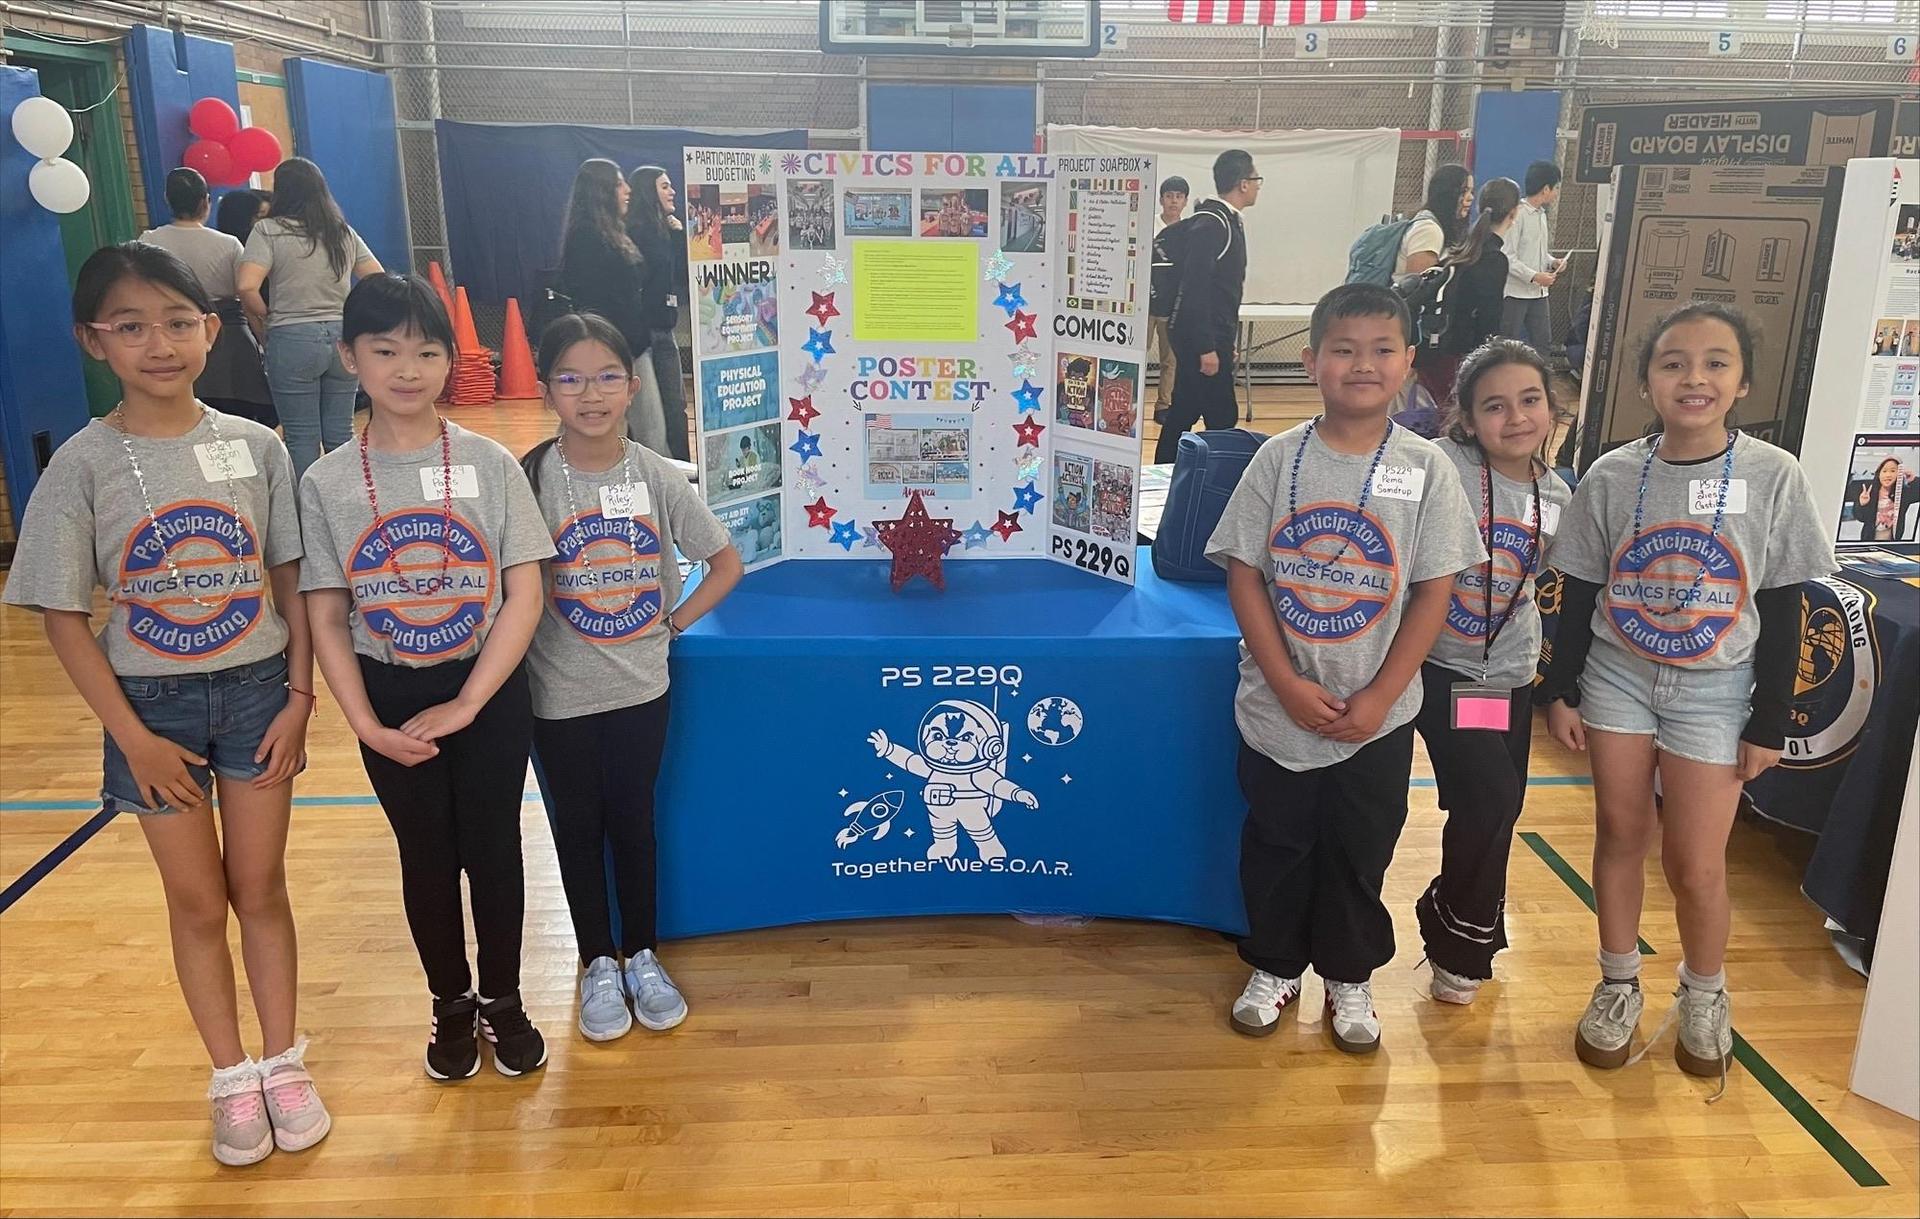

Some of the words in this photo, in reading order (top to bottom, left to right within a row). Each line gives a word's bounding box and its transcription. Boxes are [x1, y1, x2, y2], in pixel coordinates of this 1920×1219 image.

[1104, 25, 1117, 46] 2
[1305, 33, 1318, 53] 3
[1718, 32, 1732, 51] 5
[1894, 37, 1906, 56] 6
[1668, 114, 1732, 130] HEADER
[1735, 115, 1758, 125] WITH
[1630, 135, 1697, 155] BOARD
[1702, 134, 1791, 154] DISPLAY
[1825, 136, 1855, 146] WHITE
[695, 151, 756, 166] PARTICIPATORY
[804, 153, 913, 176] CIVICS
[924, 155, 986, 177] FOR
[995, 155, 1055, 178] ALL
[1058, 158, 1095, 172] PROJECT
[1099, 158, 1141, 172] SOAPBOX
[705, 167, 756, 182] BUDGETING
[703, 260, 770, 288] WINNER
[1053, 314, 1127, 345] COMICS
[720, 365, 762, 382] PHYSICAL
[858, 356, 976, 378] POSTER
[850, 381, 990, 400] CONTEST
[902, 486, 936, 498] Arica
[133, 512, 249, 561] Participatory
[361, 519, 475, 562] Paticipaory
[1282, 511, 1386, 555] Participatory
[1052, 535, 1072, 558] PS
[1075, 539, 1129, 577] 229Q
[1625, 532, 1730, 572] Participatory
[184, 573, 224, 589] FOR
[229, 569, 260, 585] ALL
[354, 578, 411, 600] CIVICS
[415, 577, 453, 593] FOR
[460, 575, 486, 590] ALL
[602, 569, 635, 584] FOR
[1320, 565, 1355, 586] FOR
[1359, 573, 1389, 592] ALL
[1611, 583, 1664, 600] CIVICS
[1667, 588, 1702, 602] FOR
[1708, 590, 1734, 605] ALL
[567, 600, 658, 636] Budgeting
[1278, 595, 1367, 634] Budgeting
[132, 610, 249, 652] Budgeting
[1621, 617, 1716, 652] Budgeting
[881, 666, 922, 687] PS
[932, 665, 1023, 687] 229Q
[831, 857, 940, 879] Together
[938, 857, 983, 873] We
[990, 858, 1073, 876] S.O.A.R.
